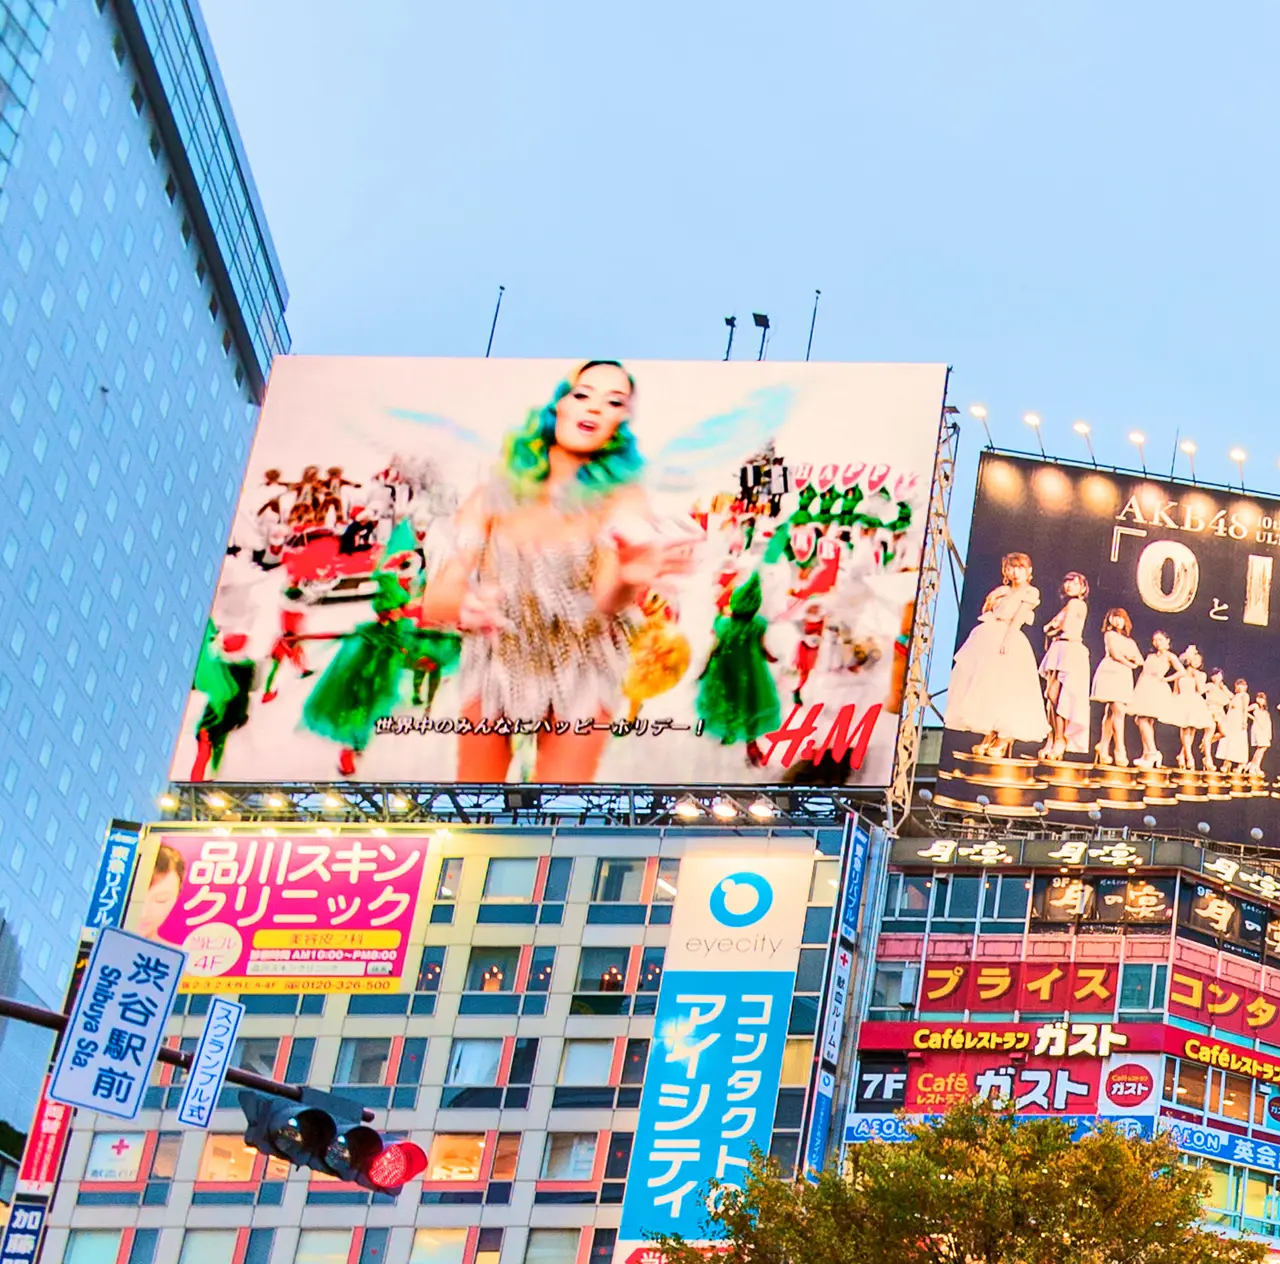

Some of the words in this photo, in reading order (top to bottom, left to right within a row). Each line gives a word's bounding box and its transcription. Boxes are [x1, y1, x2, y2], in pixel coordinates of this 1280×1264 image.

[1116, 494, 1249, 540] AKB48
[374, 716, 705, 737] 世界中のみんなにハッピーホリデー！
[761, 702, 882, 770] H&M
[188, 840, 421, 886] 品川スキン
[183, 884, 412, 927] クリニック
[194, 955, 224, 972] 4F
[686, 935, 783, 958] eyecity
[83, 965, 122, 1034] Shibuya
[926, 967, 1113, 1001] プライス
[92, 953, 170, 1104] 渋谷駅前
[828, 976, 845, 1048] 献血ルーム
[69, 1037, 99, 1073] Sta.
[1034, 1023, 1128, 1057] ガスト
[189, 1007, 233, 1120] スクランブル式
[917, 1073, 968, 1093] Café
[647, 994, 726, 1220] アイシティ
[862, 1073, 906, 1099] 7F
[975, 1067, 1091, 1110] ガスト
[1110, 1082, 1149, 1096] ガスト
